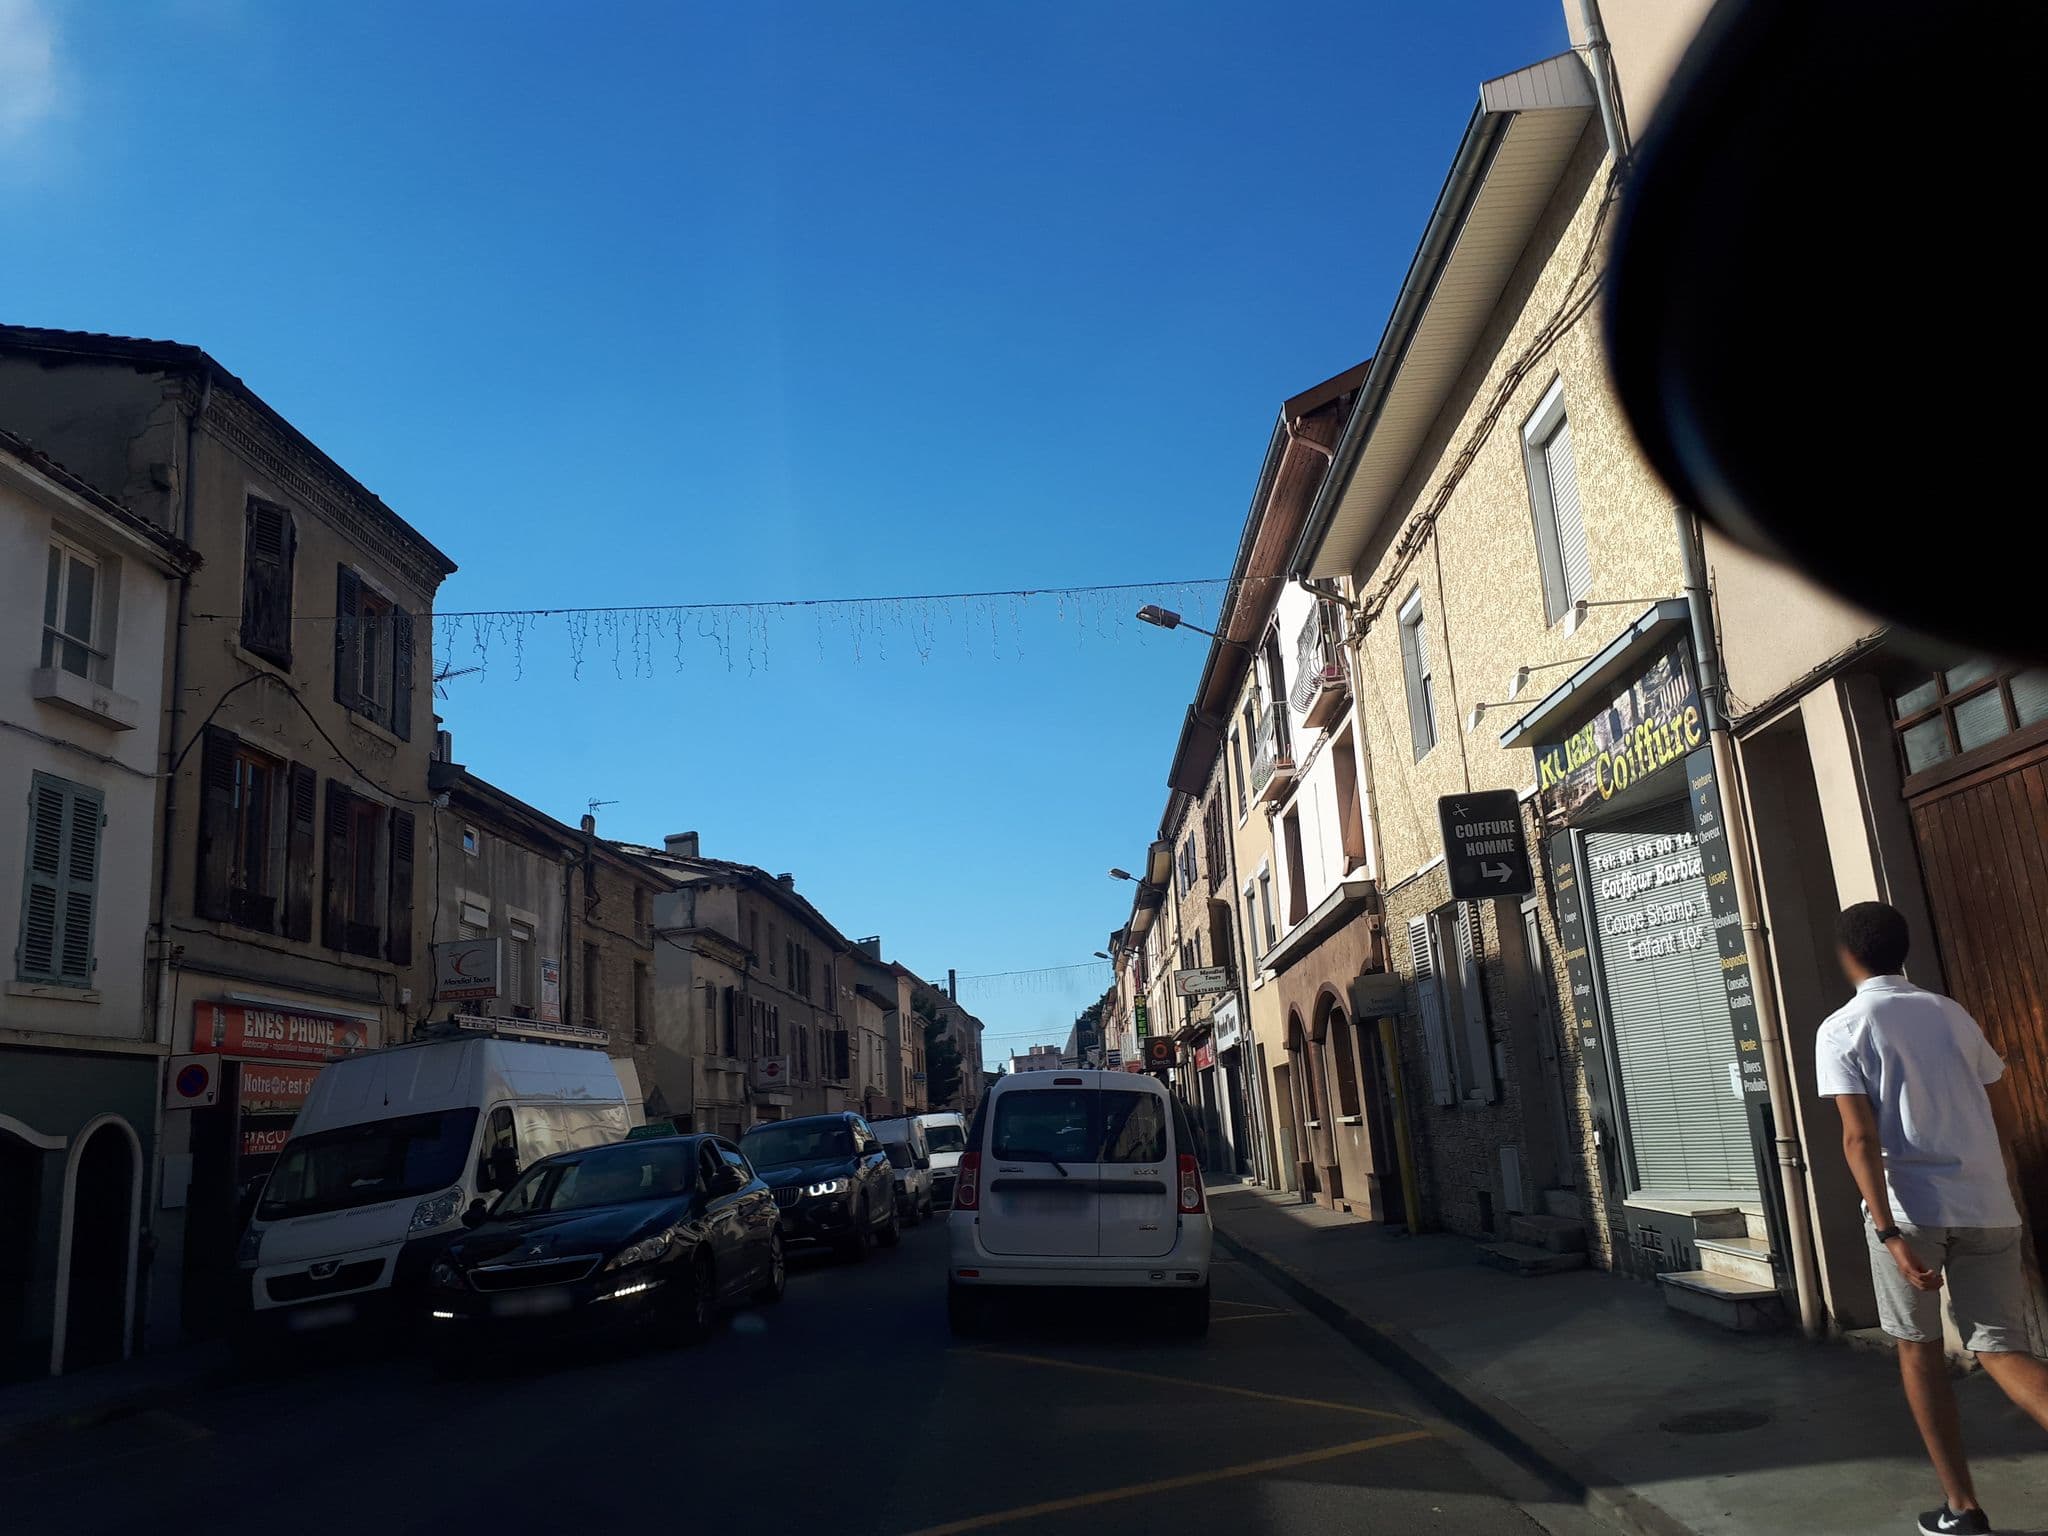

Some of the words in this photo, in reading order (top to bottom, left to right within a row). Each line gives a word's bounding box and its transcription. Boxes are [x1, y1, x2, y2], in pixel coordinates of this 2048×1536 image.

[1596, 705, 1701, 800] Coiffure
[1699, 810, 1713, 826] Soins
[1455, 819, 1516, 839] COIFFURE
[1699, 825, 1721, 844] Cheveux
[1465, 838, 1516, 857] HOMME
[1619, 847, 1634, 863] 06
[1637, 842, 1653, 859] 66
[1655, 837, 1671, 853] 00
[1601, 870, 1653, 901] Coiffeur
[1708, 870, 1728, 886] Lissage
[1604, 909, 1645, 935] Coupe
[1627, 932, 1676, 960] Enfant
[444, 976, 472, 985] Mondial
[1726, 974, 1749, 991] Conseils
[1730, 993, 1752, 1009] Gratuits
[243, 1009, 285, 1040] ENES
[288, 1015, 336, 1046] PHONE
[1739, 1039, 1758, 1053] Vente
[1743, 1060, 1761, 1073] Divers
[244, 1072, 271, 1092] Notre
[280, 1076, 302, 1094] c'est
[1743, 1077, 1768, 1093] Produits
